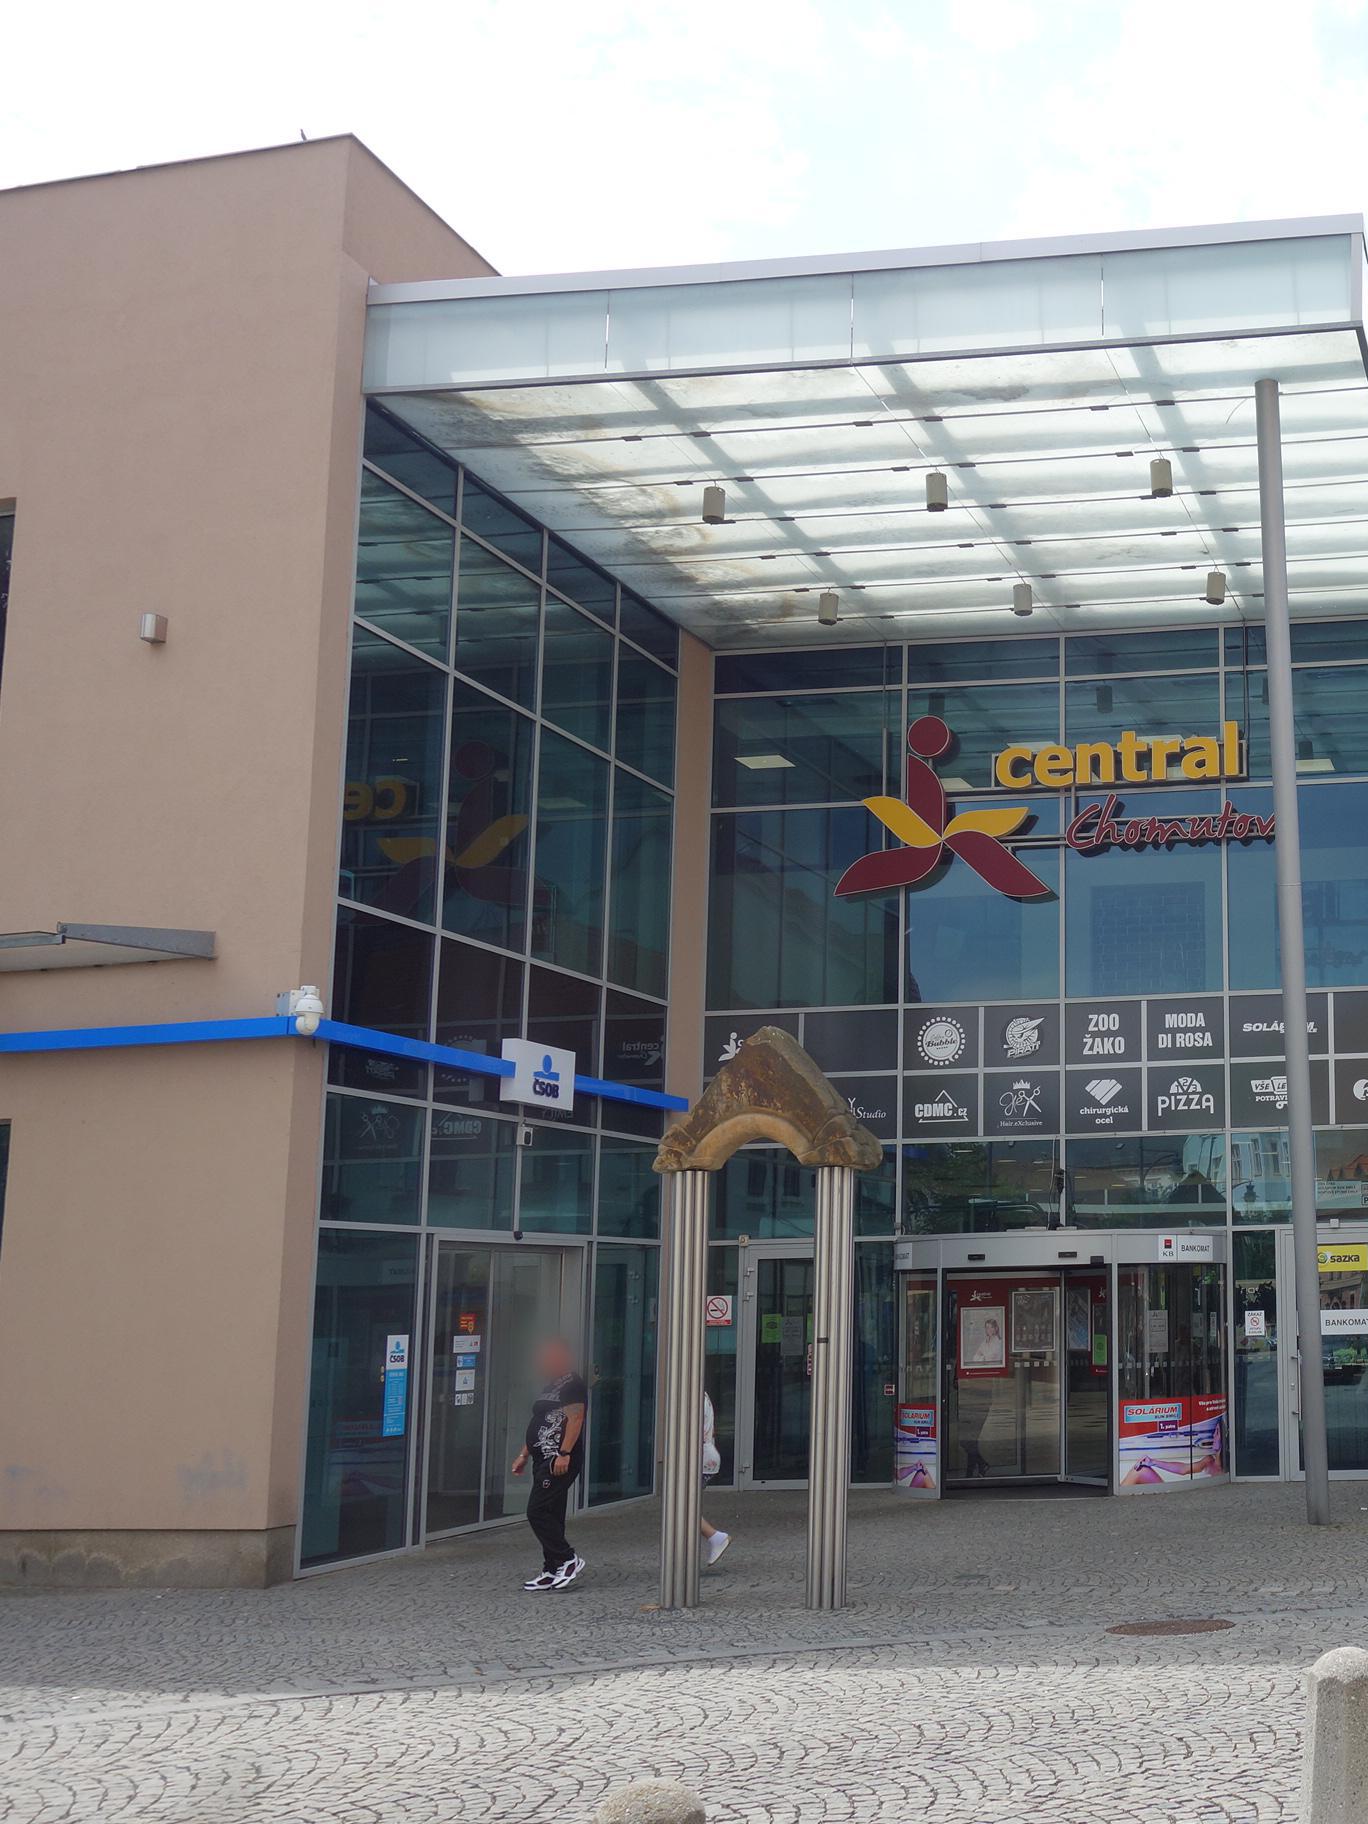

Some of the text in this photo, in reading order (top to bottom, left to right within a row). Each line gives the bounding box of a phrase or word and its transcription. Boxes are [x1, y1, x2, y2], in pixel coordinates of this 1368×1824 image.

[995, 720, 1240, 789] central
[1066, 793, 1275, 850] Chomutov
[1088, 1014, 1119, 1031] ZOO
[1165, 1013, 1205, 1028] MODA
[1083, 1035, 1125, 1055] ŽAKO
[1158, 1032, 1213, 1048] DI ROSA
[533, 1078, 560, 1098] ČSOB
[1254, 1082, 1270, 1091] VŠE
[856, 1107, 886, 1119] Studio
[914, 1103, 968, 1118] CDMC.cz
[1079, 1105, 1129, 1116] chirurgická
[1157, 1094, 1214, 1117] PIZZA
[1095, 1116, 1114, 1125] ocel
[1181, 1244, 1210, 1252] BANKOMAT
[1330, 1254, 1361, 1264] sazka
